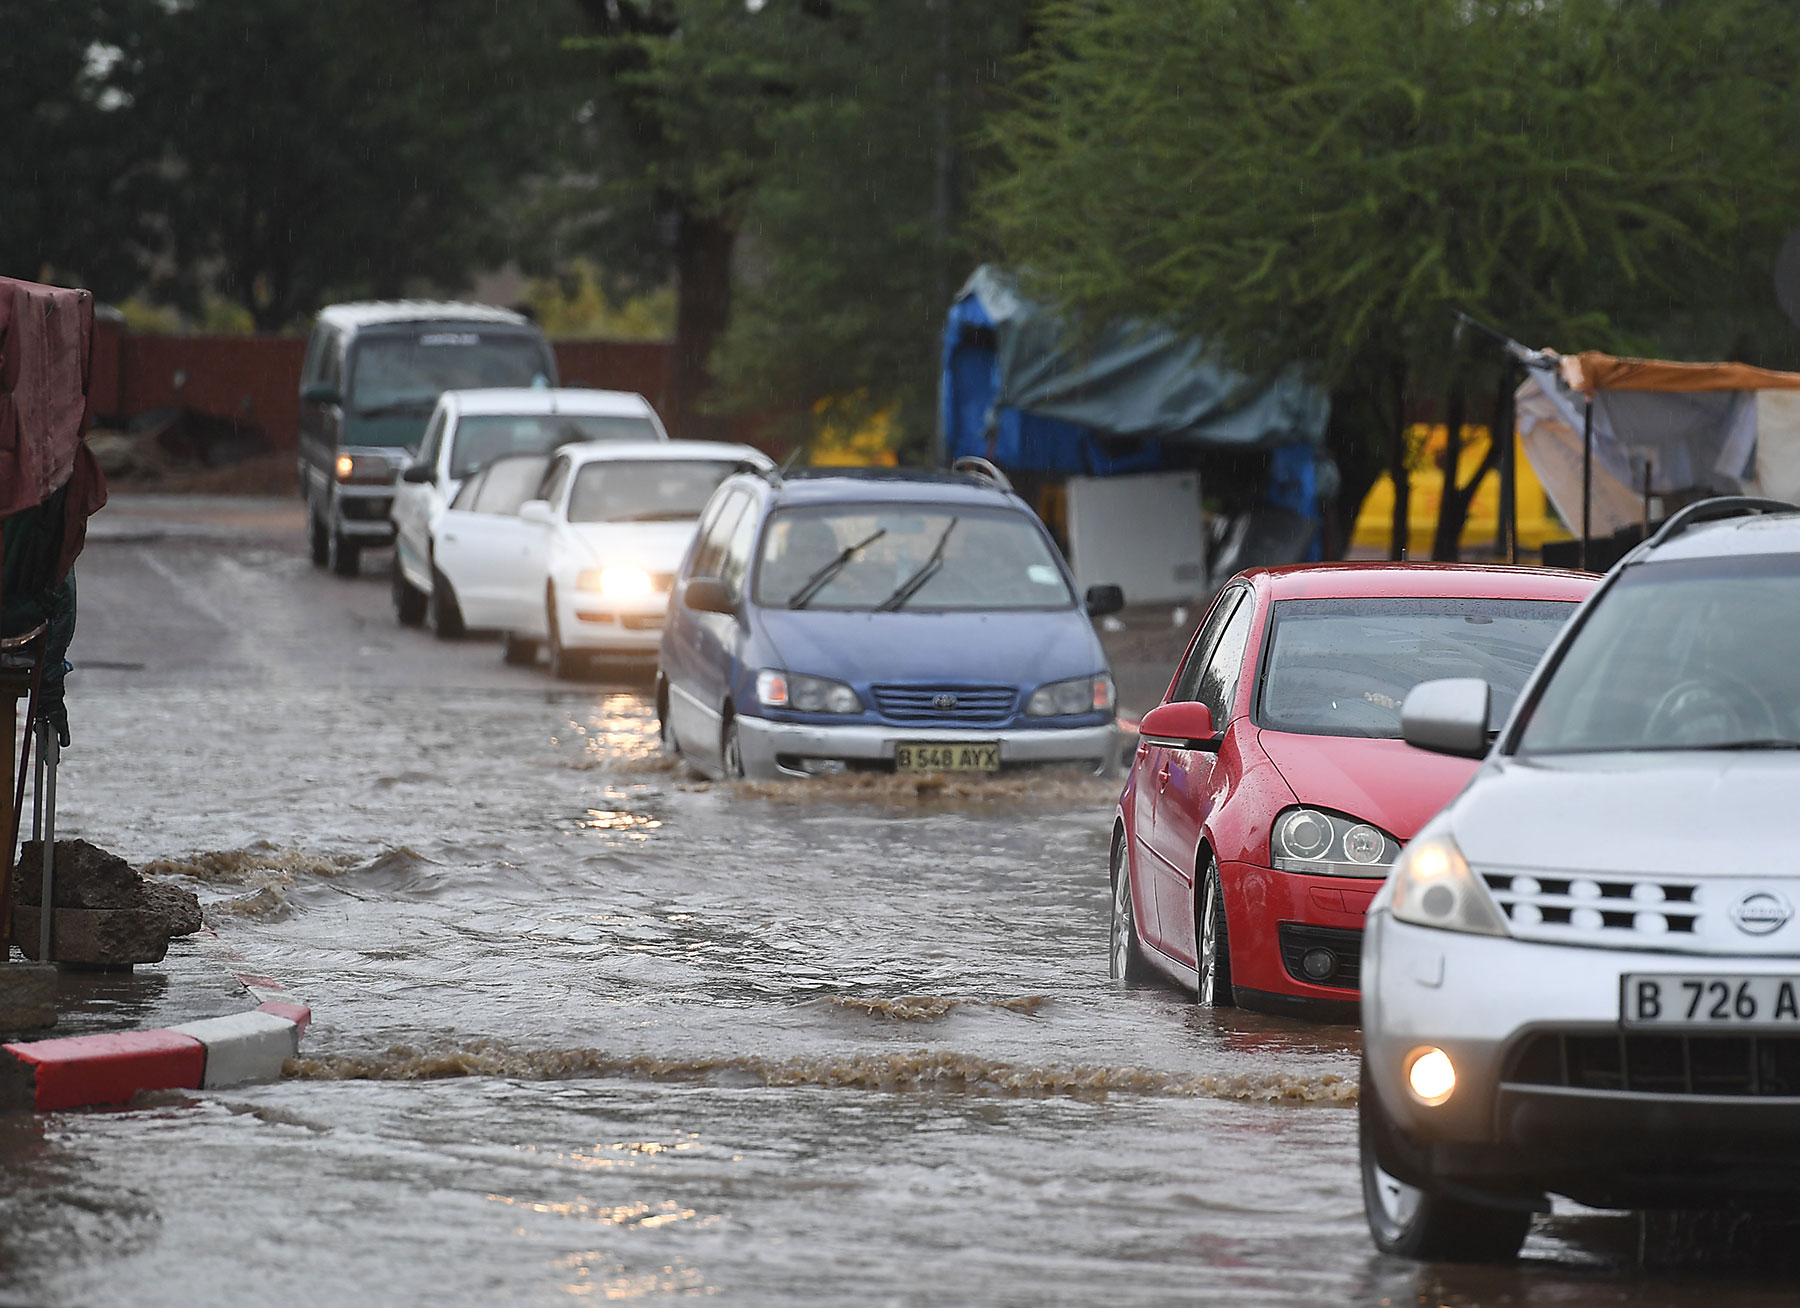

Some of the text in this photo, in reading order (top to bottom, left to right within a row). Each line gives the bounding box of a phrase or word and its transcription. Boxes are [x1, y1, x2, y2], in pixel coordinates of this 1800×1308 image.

[899, 748, 997, 768] B 548 AYX
[1638, 981, 1661, 1019] B
[1681, 981, 1758, 1019] 726
